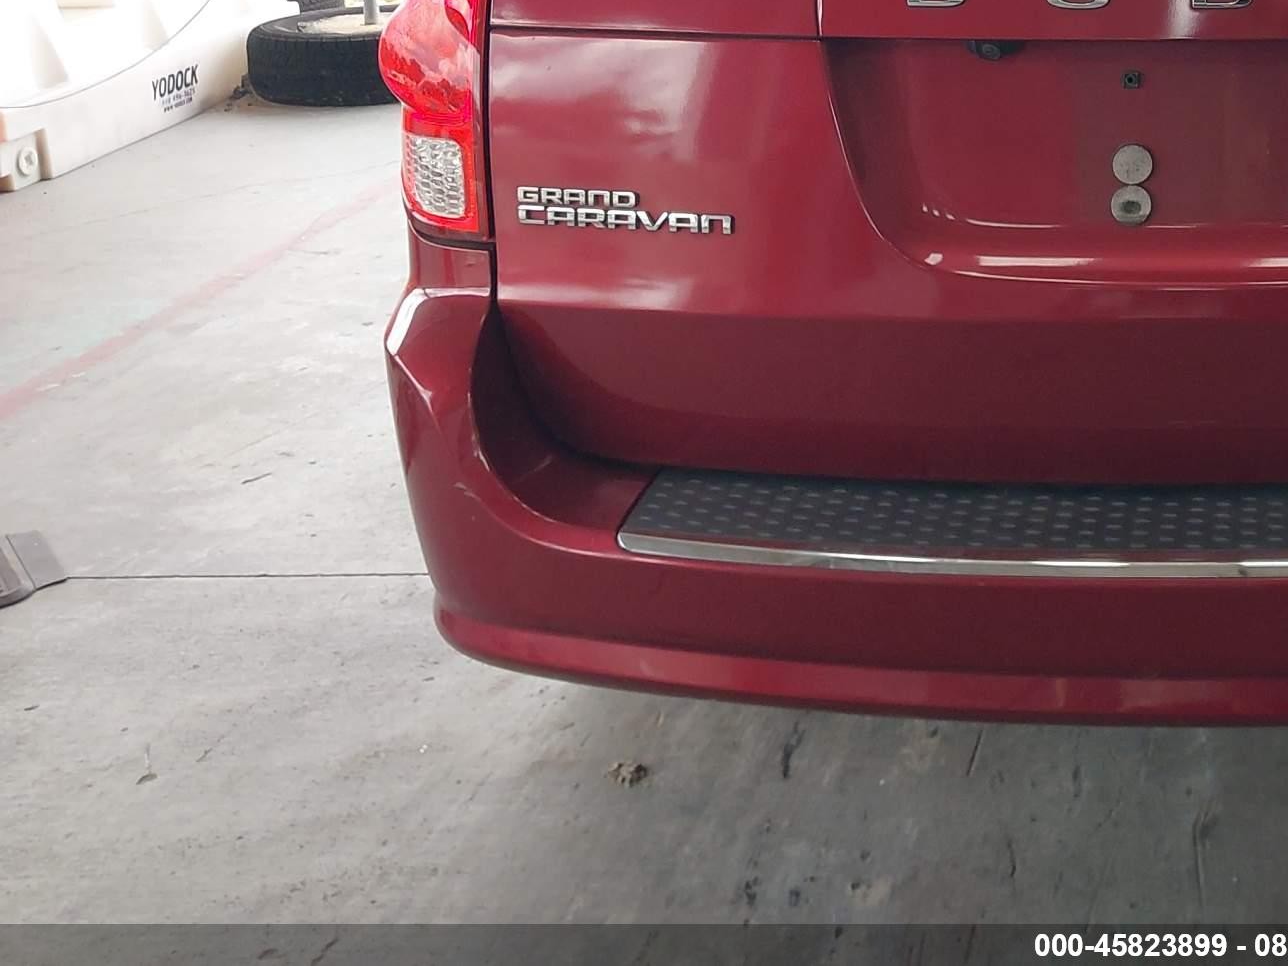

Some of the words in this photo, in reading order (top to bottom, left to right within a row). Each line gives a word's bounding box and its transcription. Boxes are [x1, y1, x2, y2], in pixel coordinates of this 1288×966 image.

[152, 64, 198, 100] YODOCK
[516, 185, 639, 208] GRAND
[516, 204, 735, 235] CARAVAN
